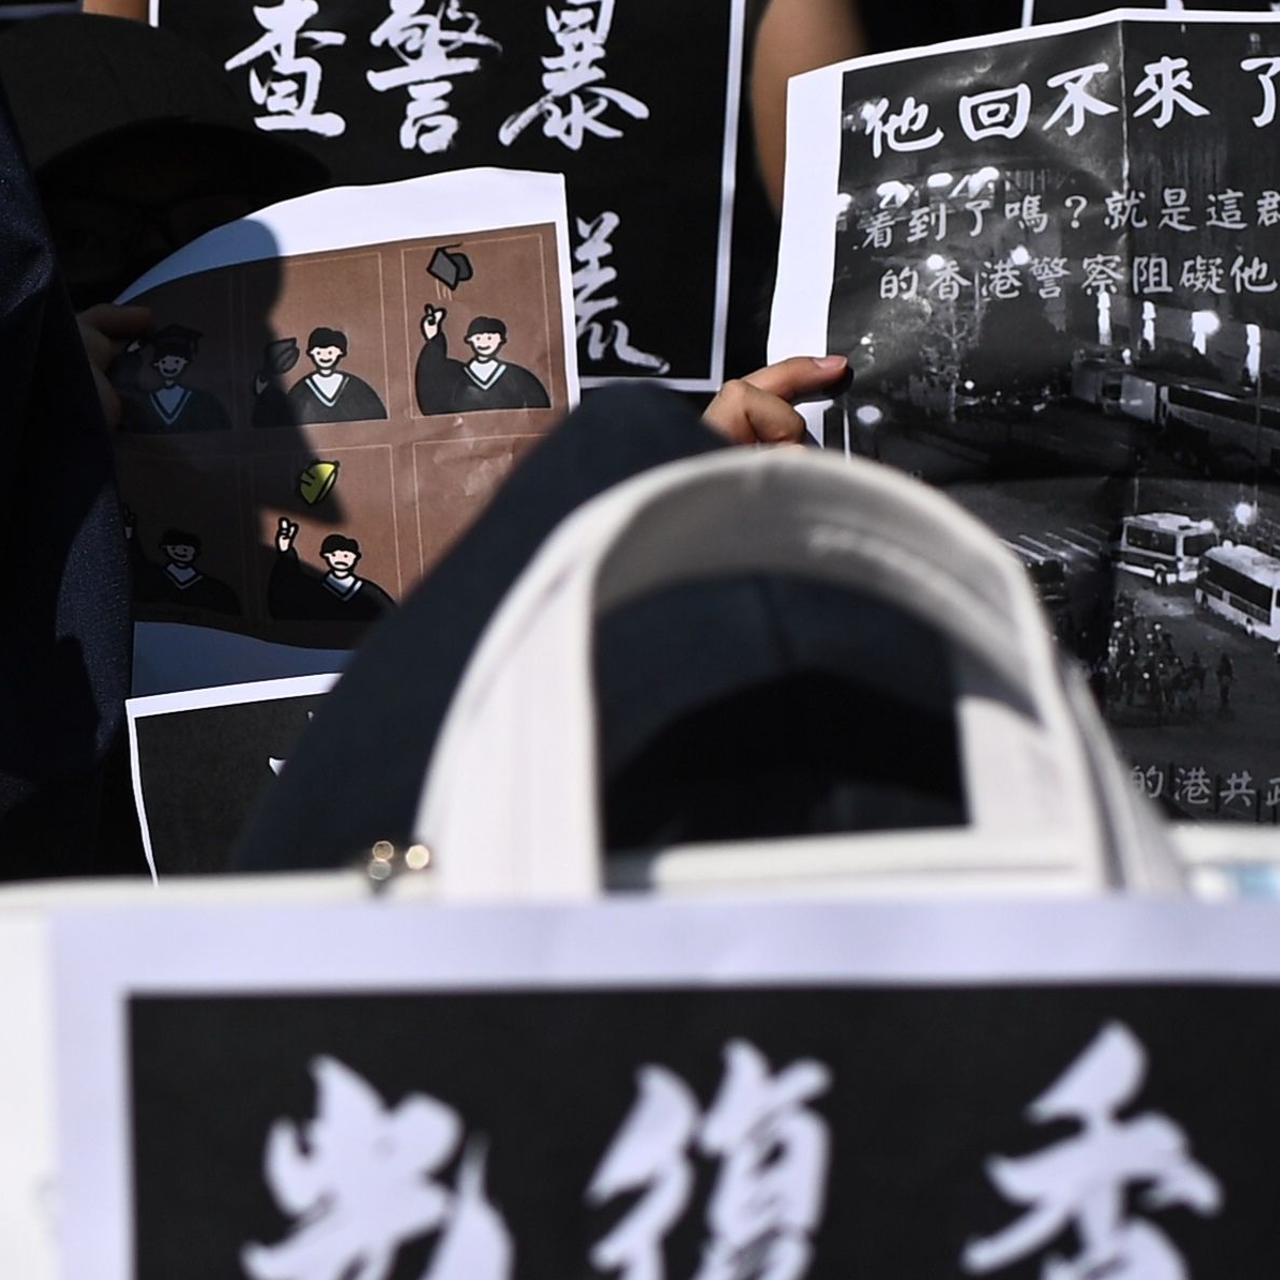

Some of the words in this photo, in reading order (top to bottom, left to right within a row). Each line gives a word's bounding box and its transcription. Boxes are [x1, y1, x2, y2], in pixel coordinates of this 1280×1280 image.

[880, 253, 1279, 302] 的香港警察阻礙他
